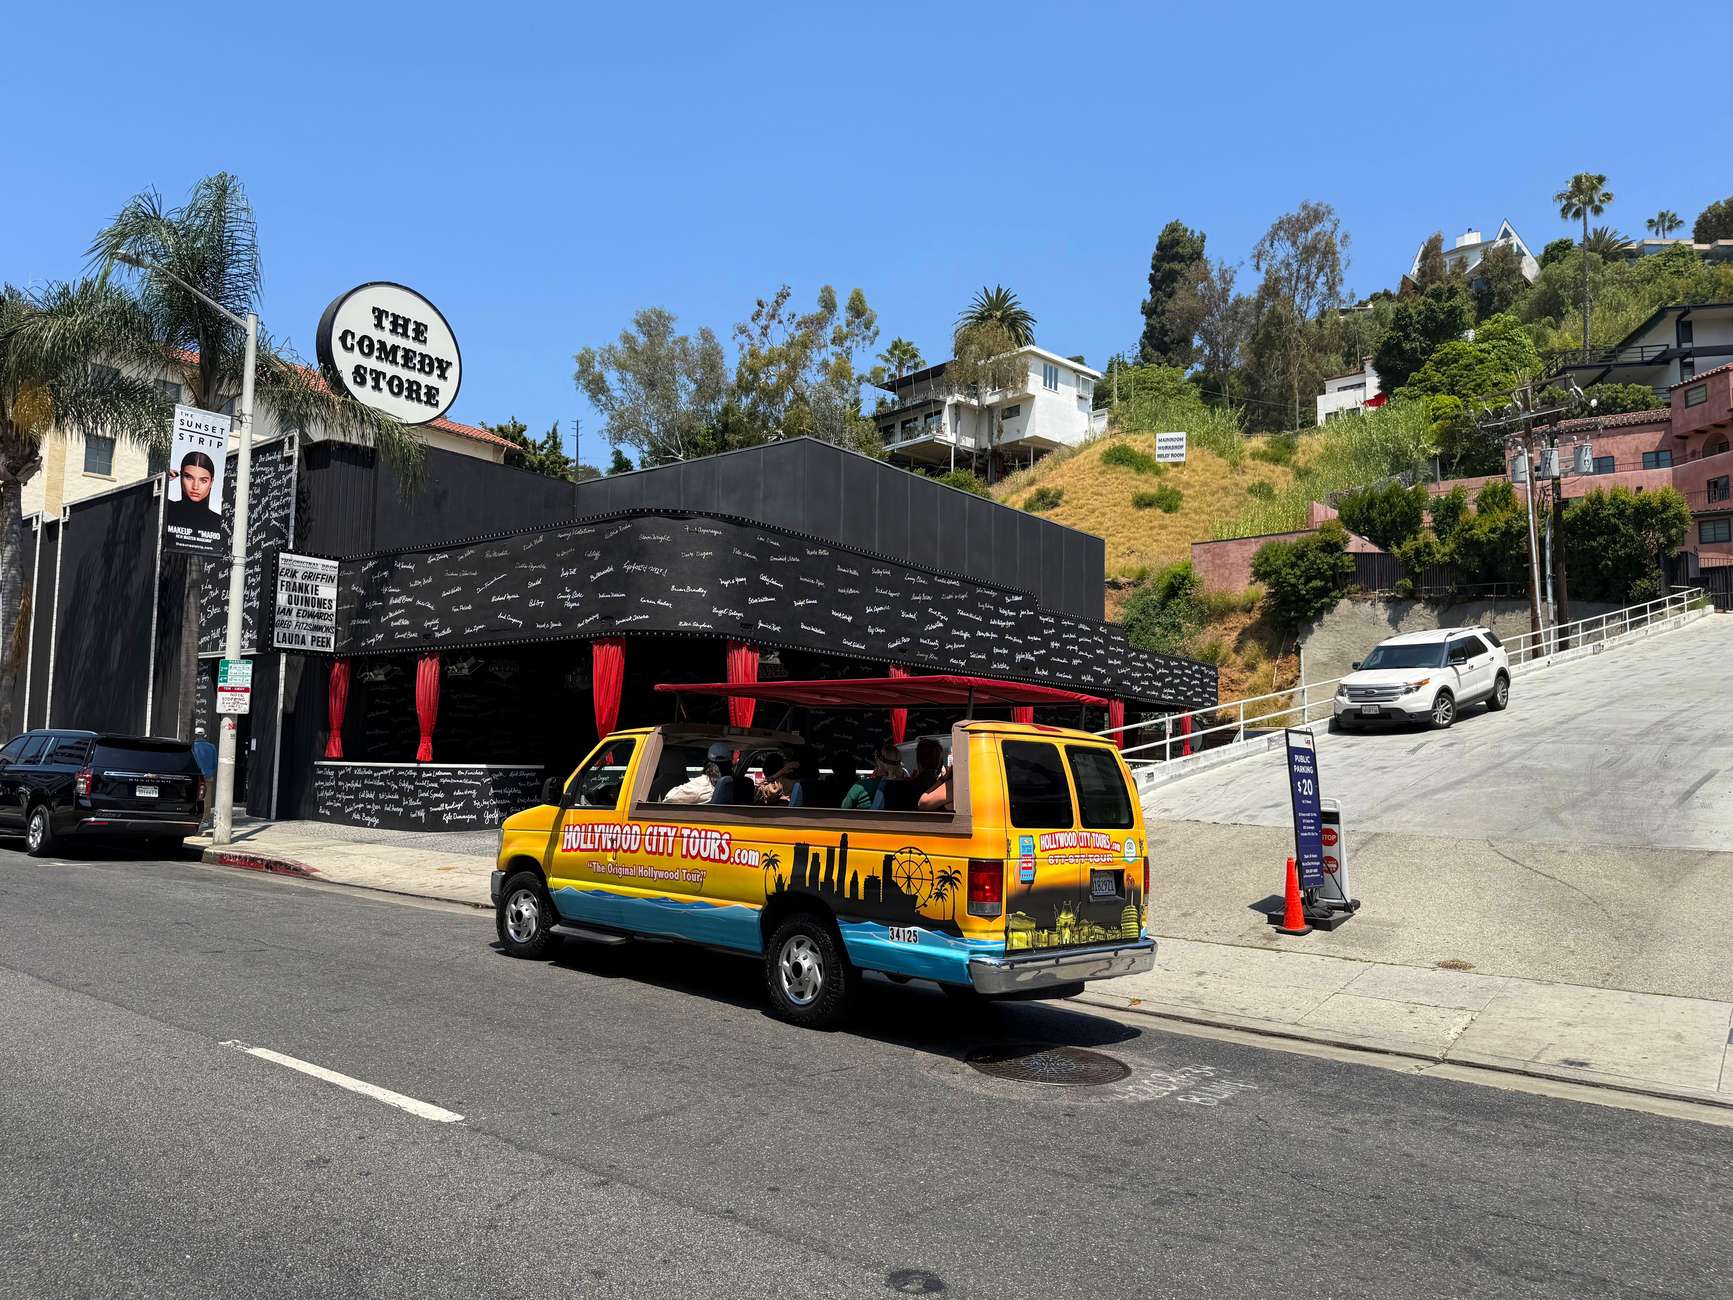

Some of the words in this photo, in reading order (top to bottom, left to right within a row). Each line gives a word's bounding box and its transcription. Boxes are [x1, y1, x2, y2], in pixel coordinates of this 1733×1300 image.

[372, 306, 428, 344] THE
[338, 329, 453, 381] COMEDY
[352, 364, 440, 408] STORE
[180, 418, 225, 435] SUNSET
[178, 432, 223, 449] STRIP
[167, 524, 193, 536] MAKEUP
[201, 530, 221, 540] MARIO
[279, 567, 299, 580] ERIK
[301, 571, 336, 584] GRIFFIN
[280, 580, 320, 596] FRANKIE
[287, 594, 333, 610] QUINONES
[276, 606, 293, 617] IAN
[296, 609, 334, 622] EDWARDS
[275, 619, 292, 630] GREG
[294, 621, 335, 634] FITZSIMMONS
[276, 632, 306, 646] LAURA
[310, 635, 332, 648] PEEK
[1294, 754, 1311, 763] PUBLIC
[1293, 765, 1314, 774] PARKING
[562, 824, 642, 852] HOLLYWOOD
[644, 826, 678, 856] CITY
[1040, 831, 1077, 852] HOLLYWOOD
[1078, 831, 1092, 848] CITY
[607, 864, 636, 878] Original
[638, 866, 680, 881] Hollywood
[889, 927, 918, 944] 34125
